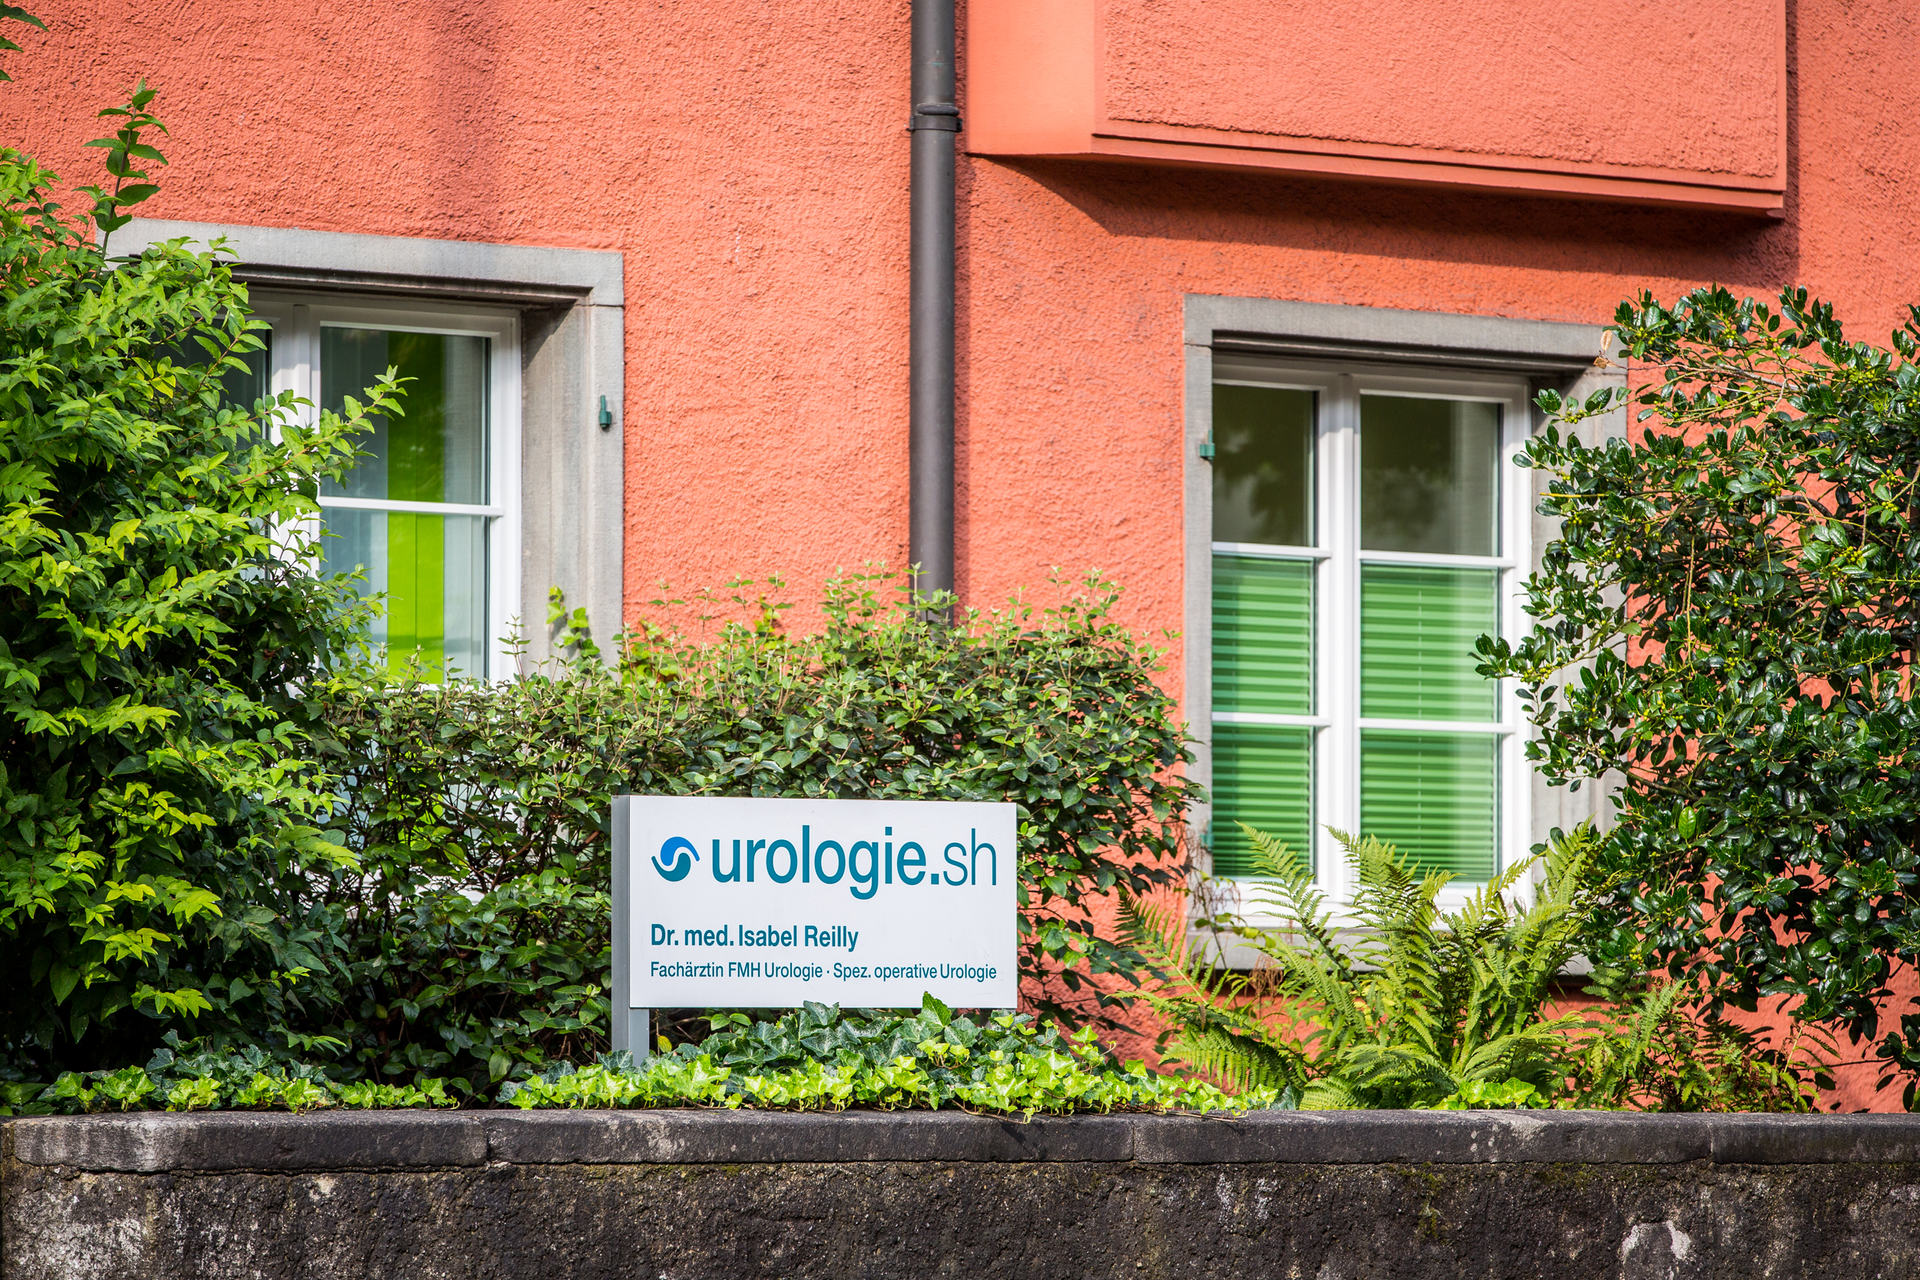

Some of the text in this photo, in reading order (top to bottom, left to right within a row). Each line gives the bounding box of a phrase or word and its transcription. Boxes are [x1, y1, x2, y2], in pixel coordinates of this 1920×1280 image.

[711, 824, 997, 900] urologie.sh
[650, 923, 859, 953] Dr. med. Isabel Reilly
[650, 961, 997, 983] Fachärztin FMH Urologie Spez. operative Urologie
